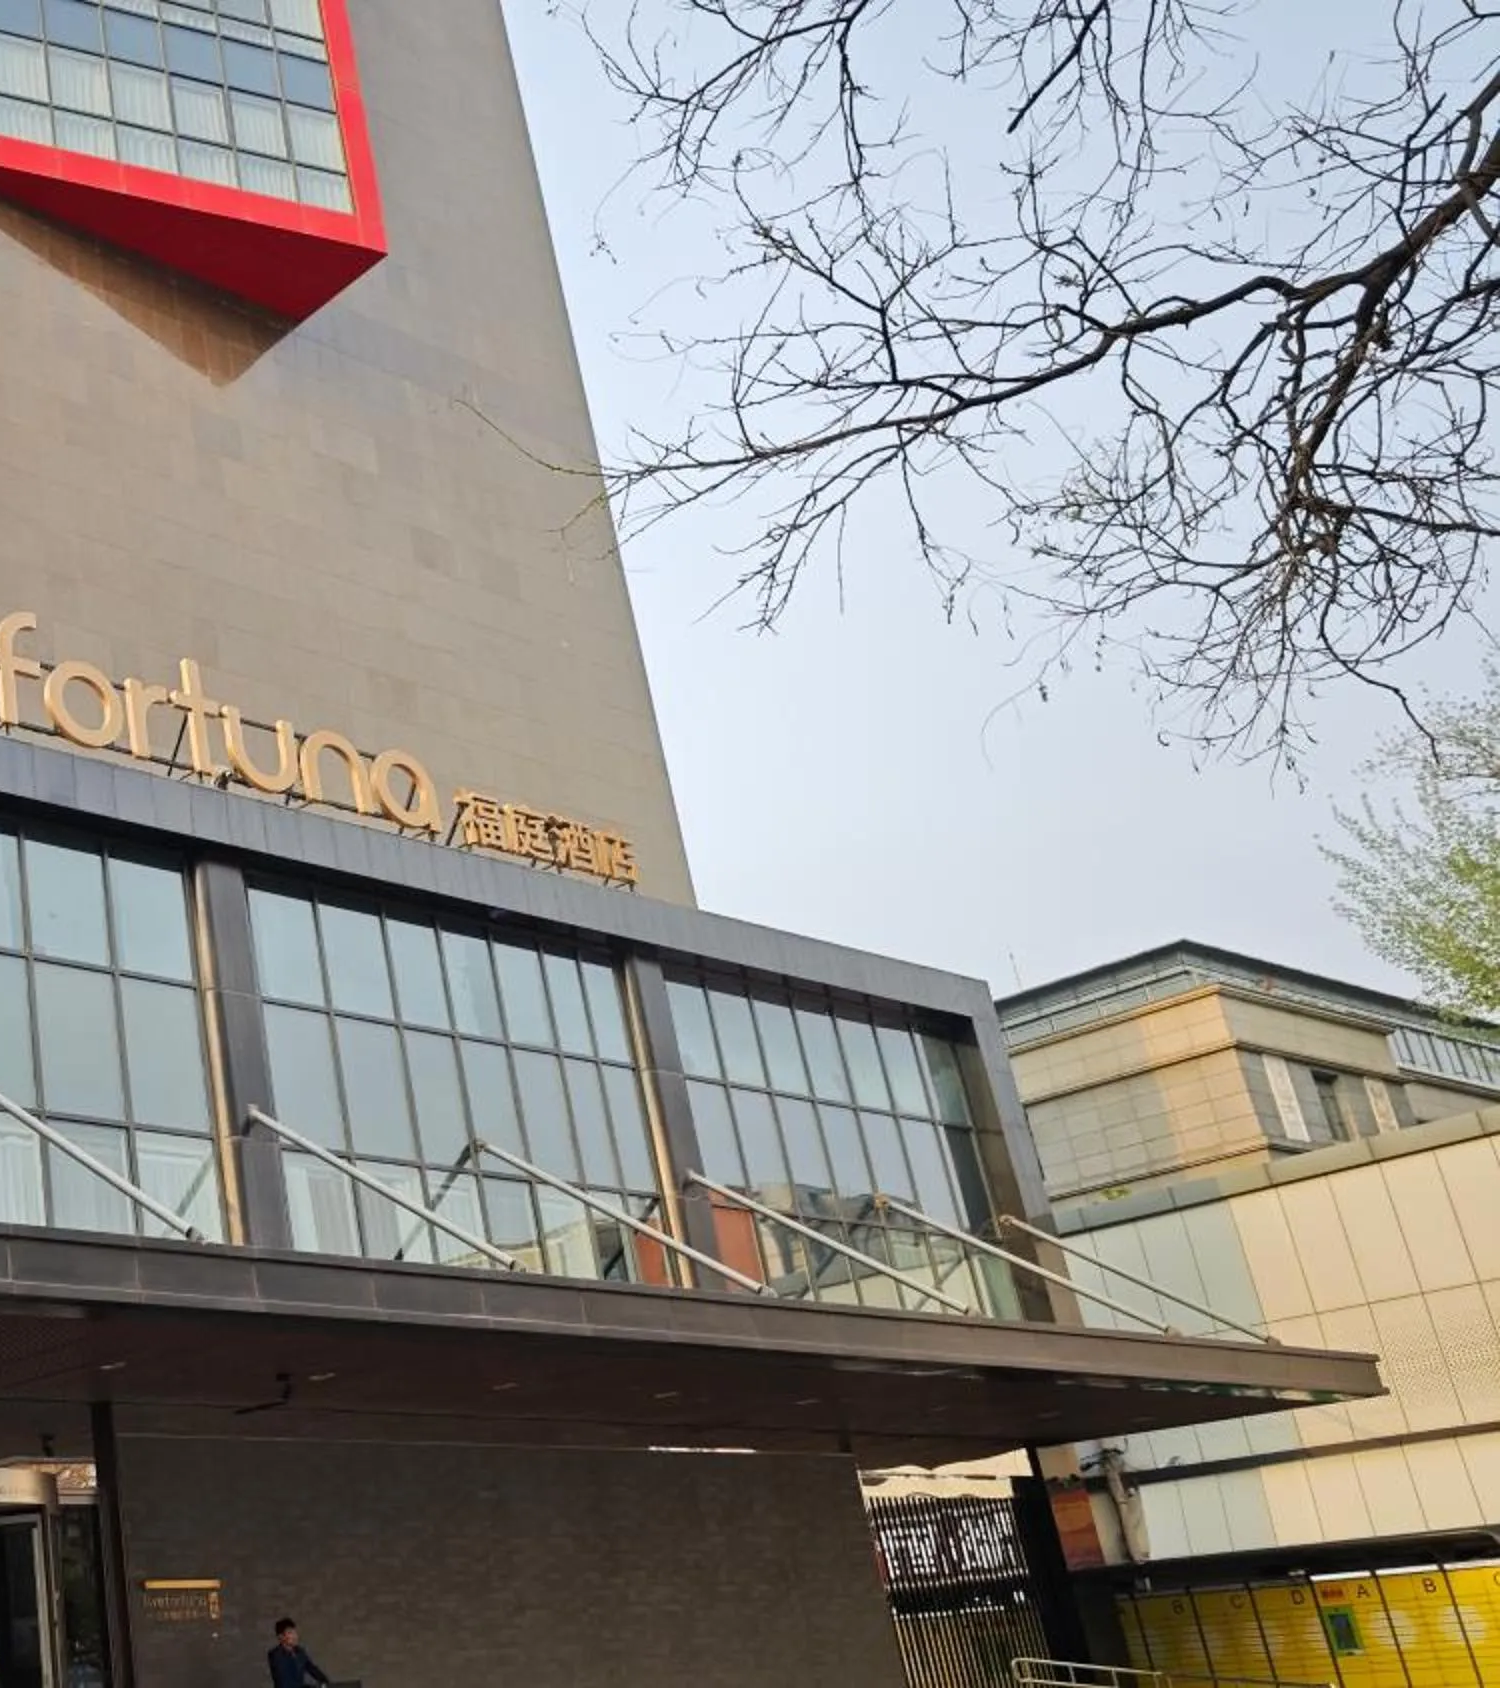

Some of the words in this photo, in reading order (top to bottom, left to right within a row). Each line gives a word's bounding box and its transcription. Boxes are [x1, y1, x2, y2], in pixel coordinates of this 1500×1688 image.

[453, 788, 640, 884] 福庭酒店
[1356, 1583, 1371, 1599] A
[1422, 1577, 1437, 1593] B
[1230, 1594, 1246, 1610] C
[1291, 1589, 1305, 1605] D
